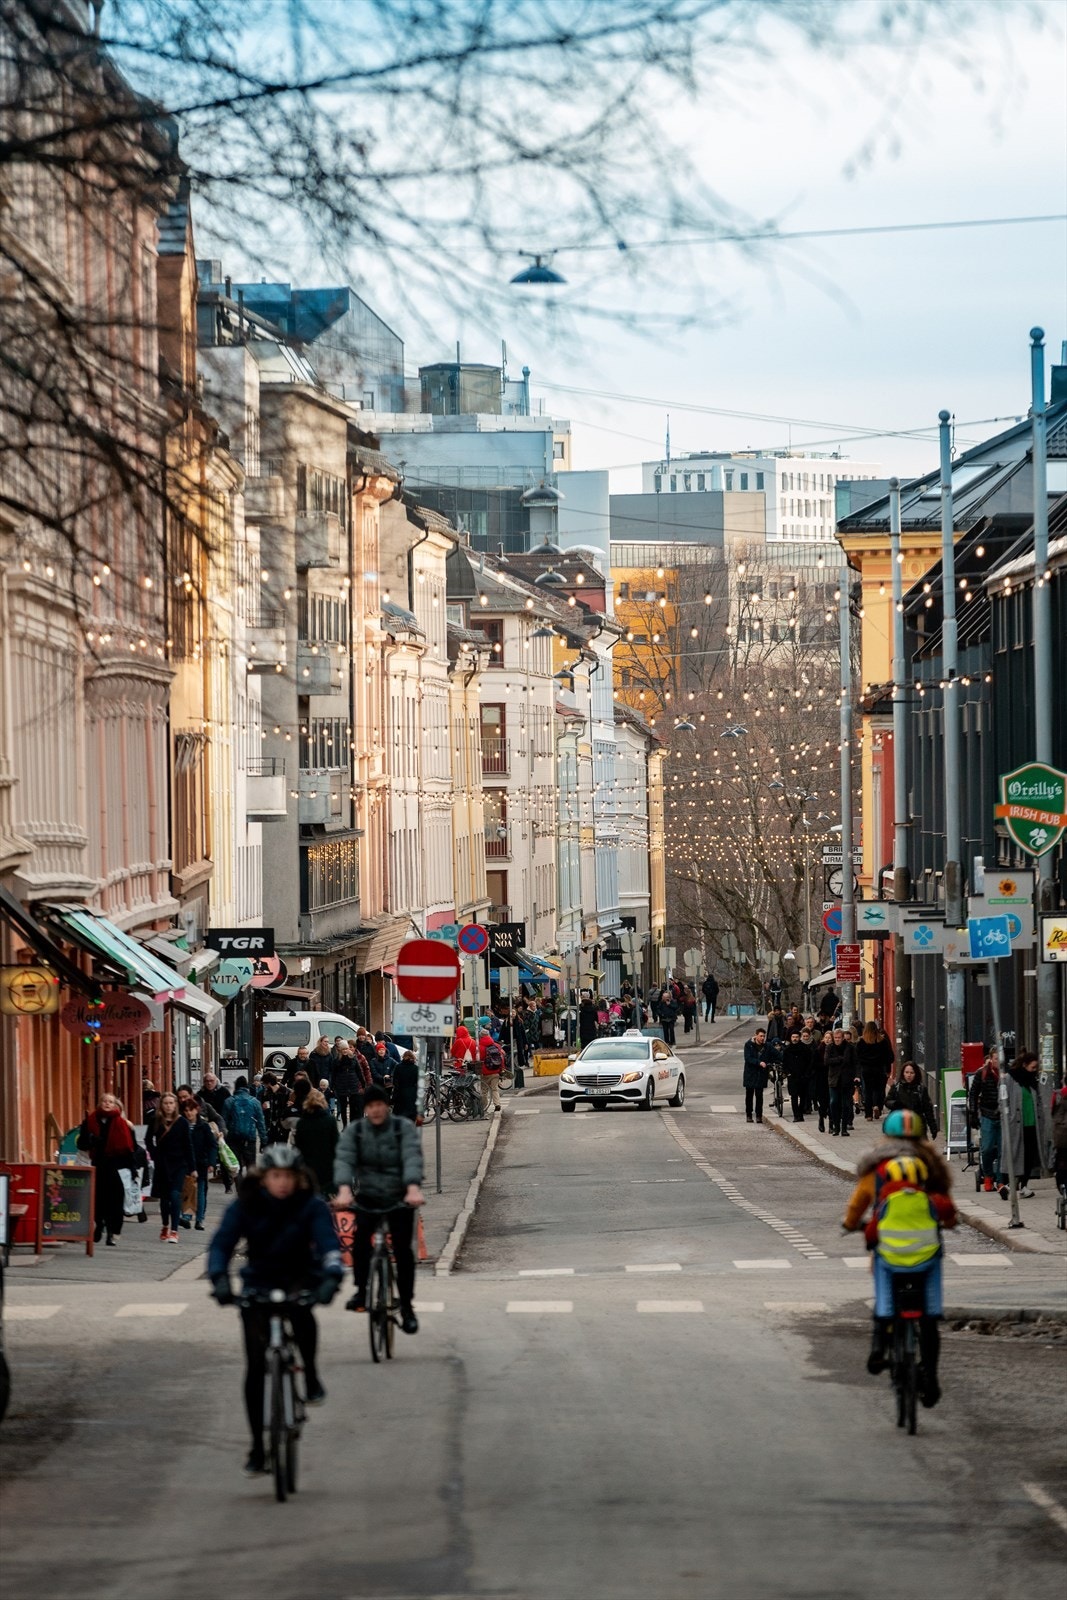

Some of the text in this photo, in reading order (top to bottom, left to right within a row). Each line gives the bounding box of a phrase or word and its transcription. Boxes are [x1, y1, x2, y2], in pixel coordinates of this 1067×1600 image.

[1010, 806, 1061, 826] IRISH PUB
[218, 937, 265, 950] TGR
[213, 975, 240, 984] VITA
[406, 1025, 440, 1033] unntatt
